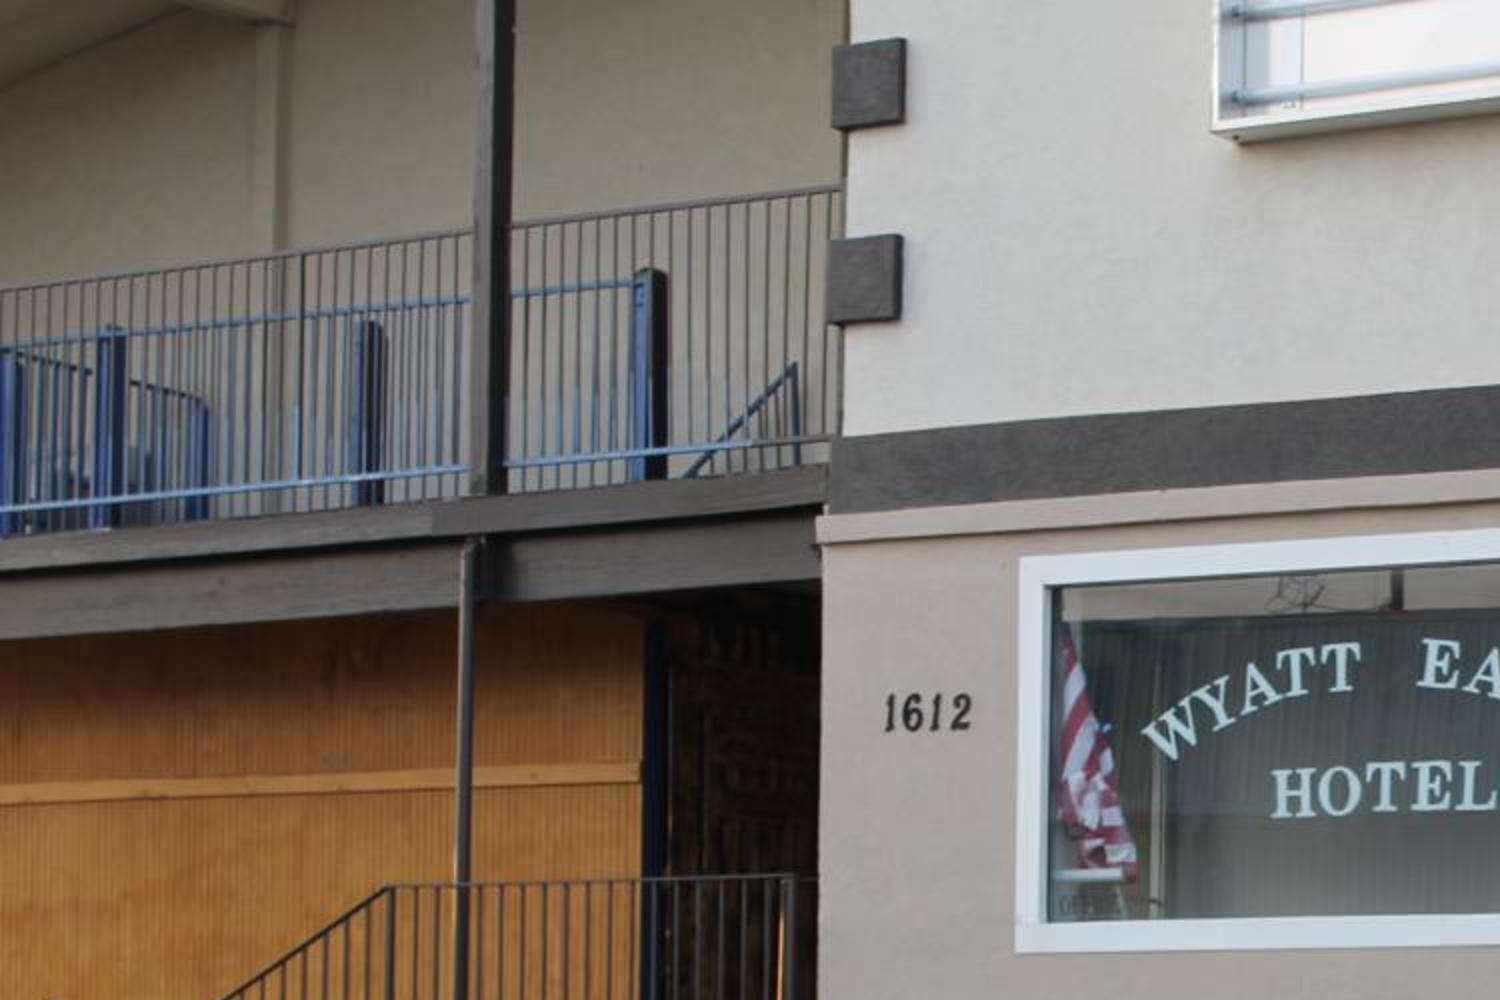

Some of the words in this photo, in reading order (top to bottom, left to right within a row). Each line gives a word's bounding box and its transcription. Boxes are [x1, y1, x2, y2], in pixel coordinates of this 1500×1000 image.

[884, 693, 972, 732] 1612
[1141, 641, 1362, 762] WYATT
[1269, 760, 1498, 819] HOTEL
